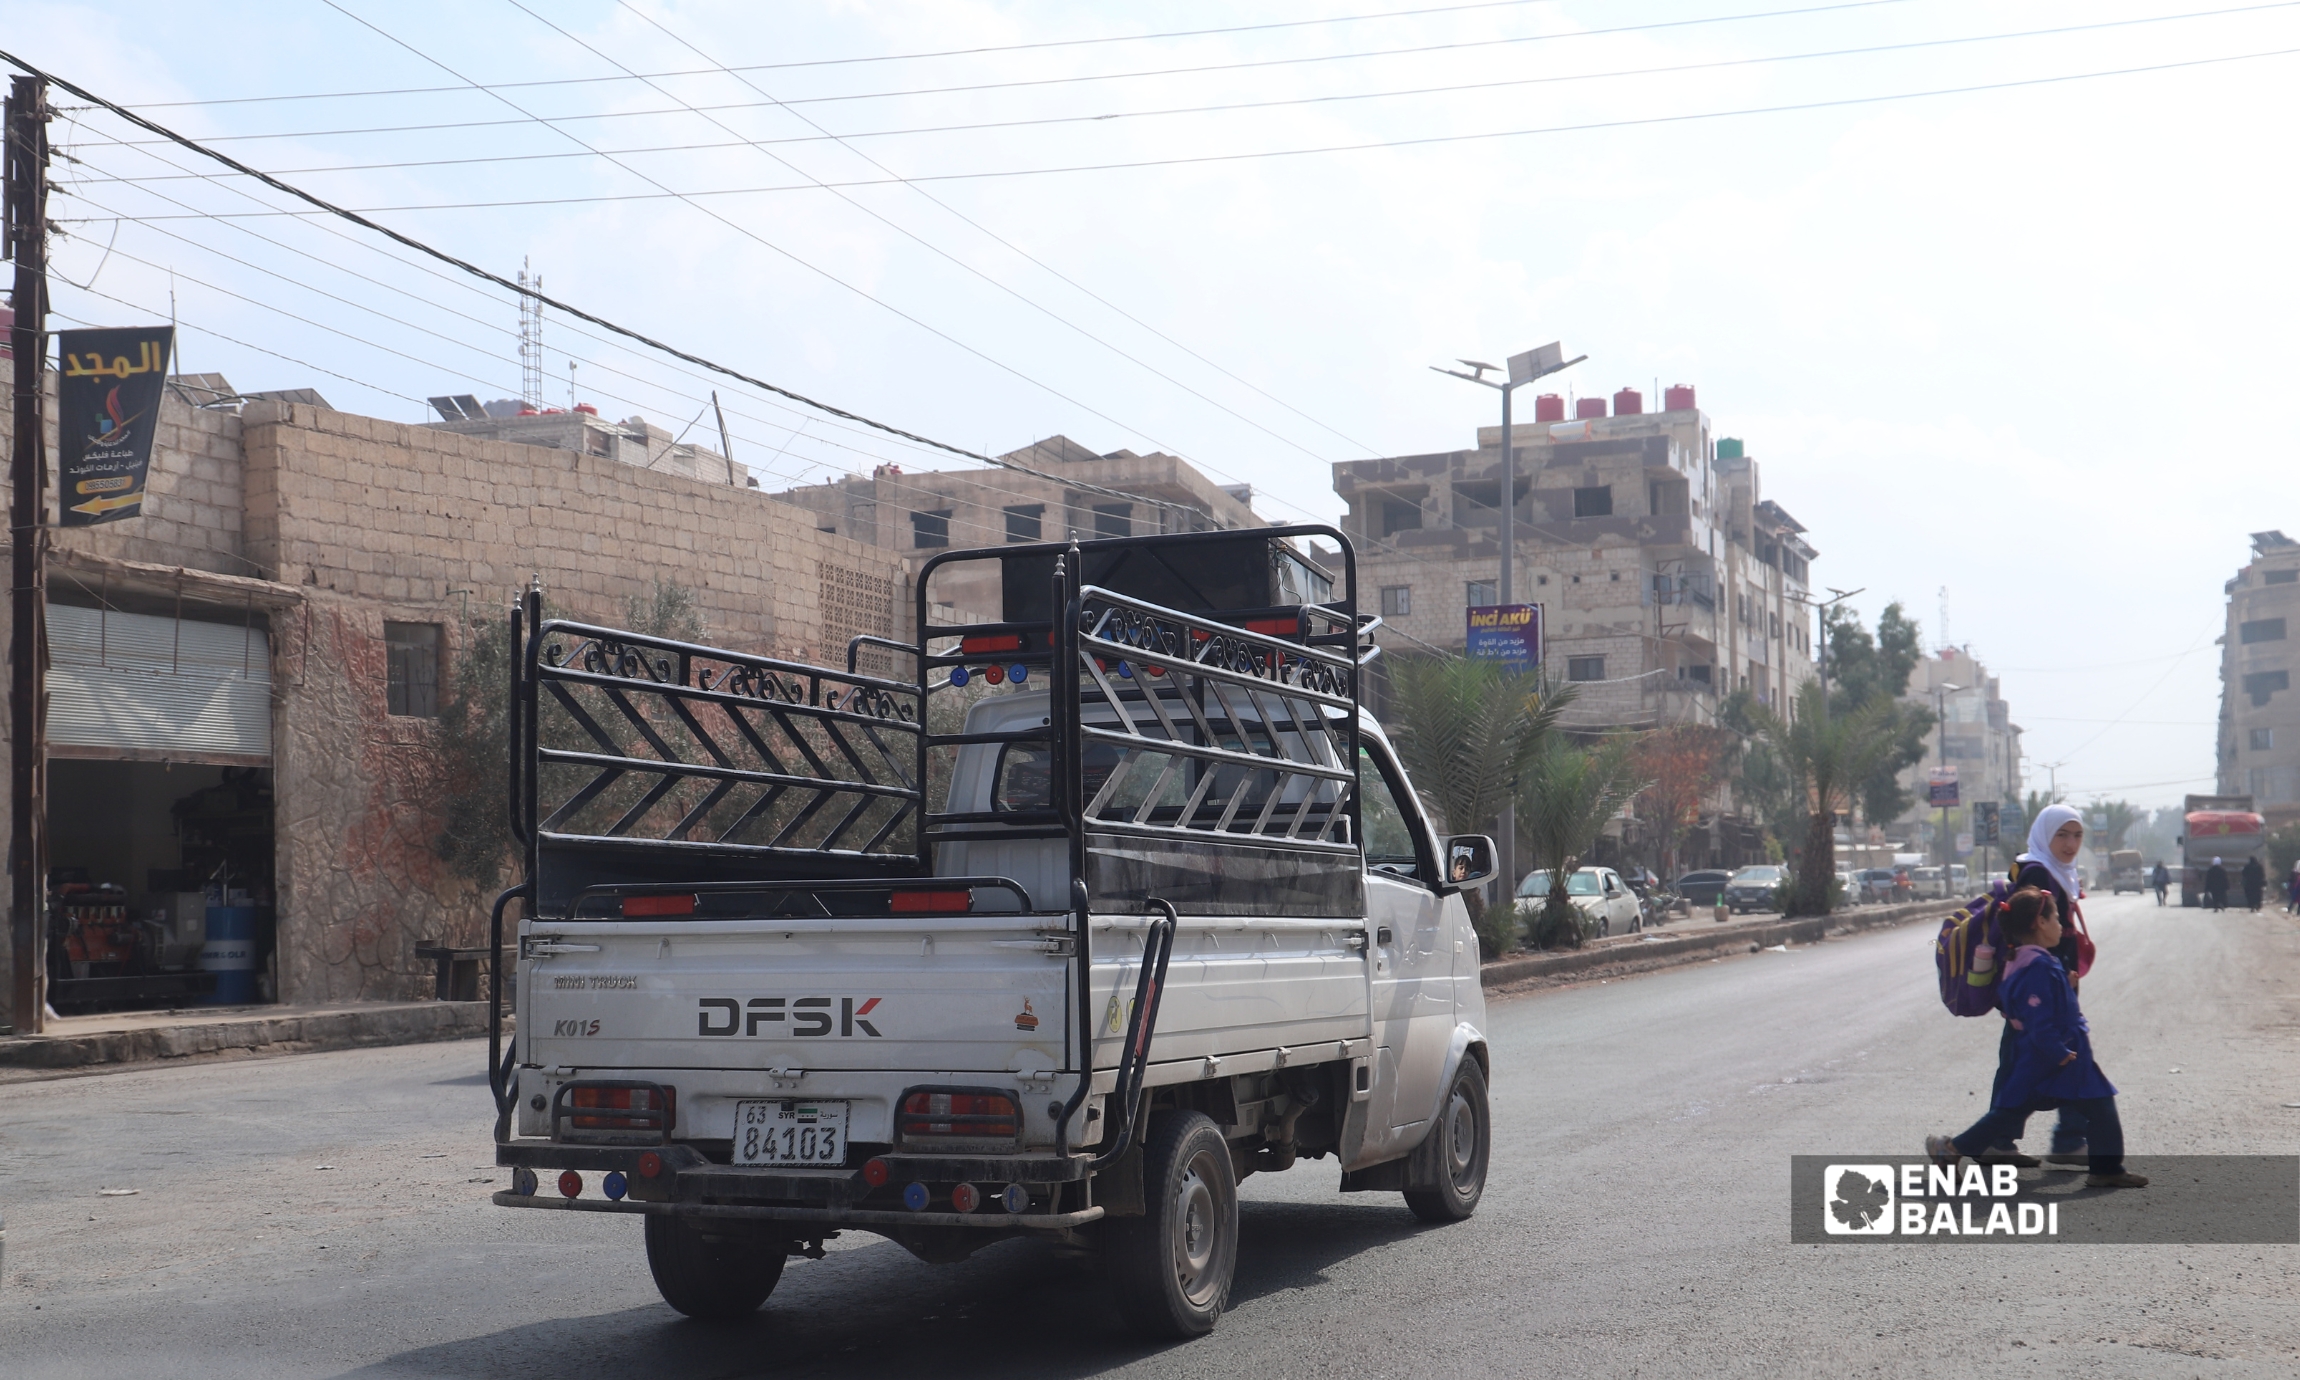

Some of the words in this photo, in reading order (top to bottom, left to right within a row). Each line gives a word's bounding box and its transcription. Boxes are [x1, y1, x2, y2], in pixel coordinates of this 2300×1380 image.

[65, 341, 161, 384] المجد
[110, 449, 134, 459] طباعة
[1499, 608, 1531, 625] AKÜ
[1478, 638, 1497, 648] القوة
[1501, 649, 1510, 657] من
[1512, 648, 1527, 656] مزيد
[554, 975, 586, 990] MINI
[589, 975, 637, 990] TRUCK
[699, 997, 883, 1037] DFSK
[553, 1019, 601, 1037] K01S
[746, 1105, 767, 1124] 63
[778, 1111, 795, 1120] SYR
[820, 1110, 839, 1120] سورية
[743, 1127, 837, 1160] 84103
